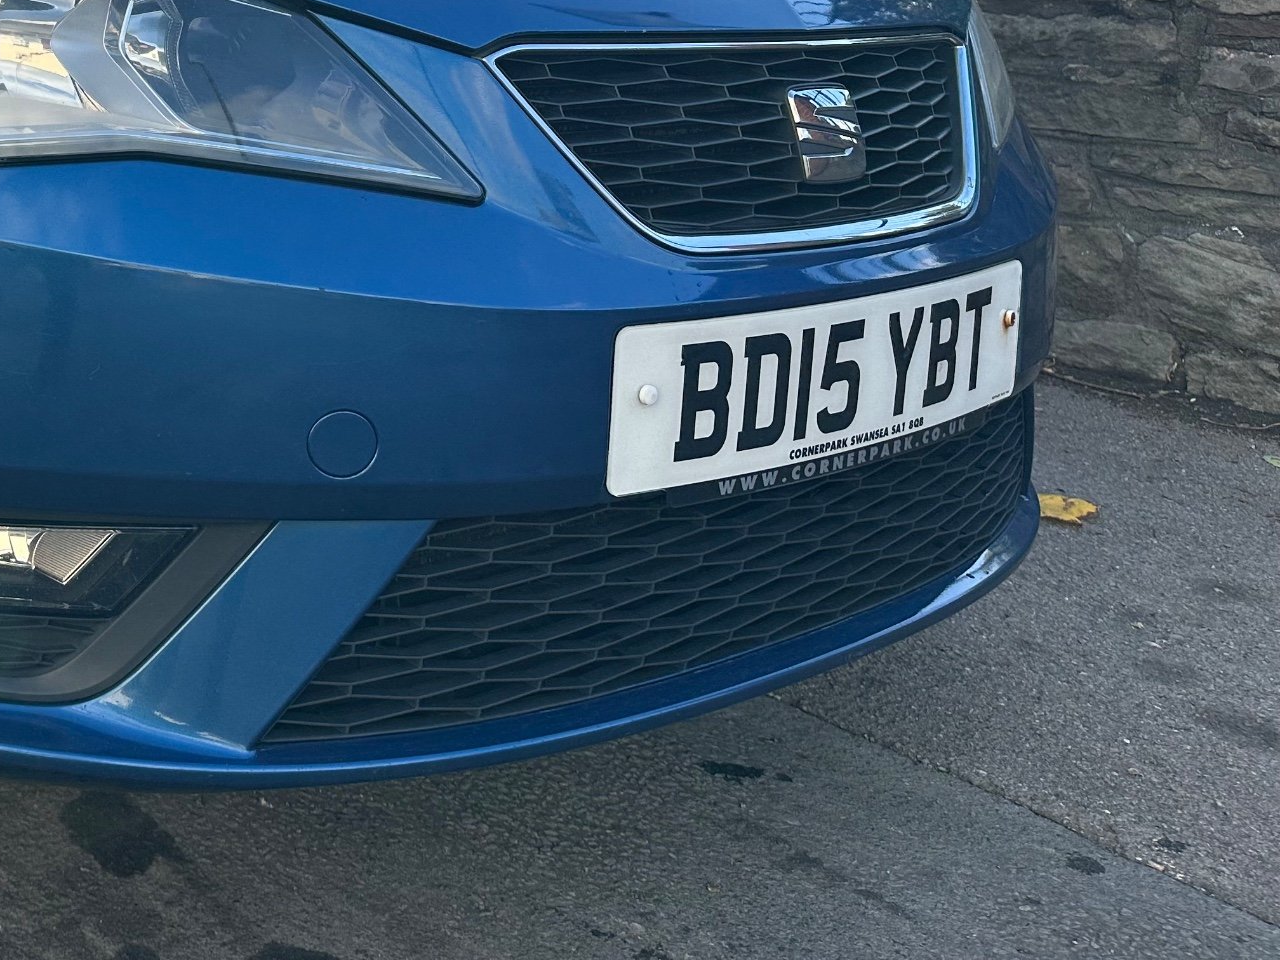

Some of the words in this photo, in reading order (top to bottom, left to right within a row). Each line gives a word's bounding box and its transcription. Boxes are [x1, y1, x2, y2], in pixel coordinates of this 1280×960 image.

[673, 319, 866, 463] BD15
[889, 286, 993, 417] YBT
[789, 437, 848, 460] CORNERPARK
[850, 427, 889, 446] SWANSEA
[891, 421, 906, 434] SA1
